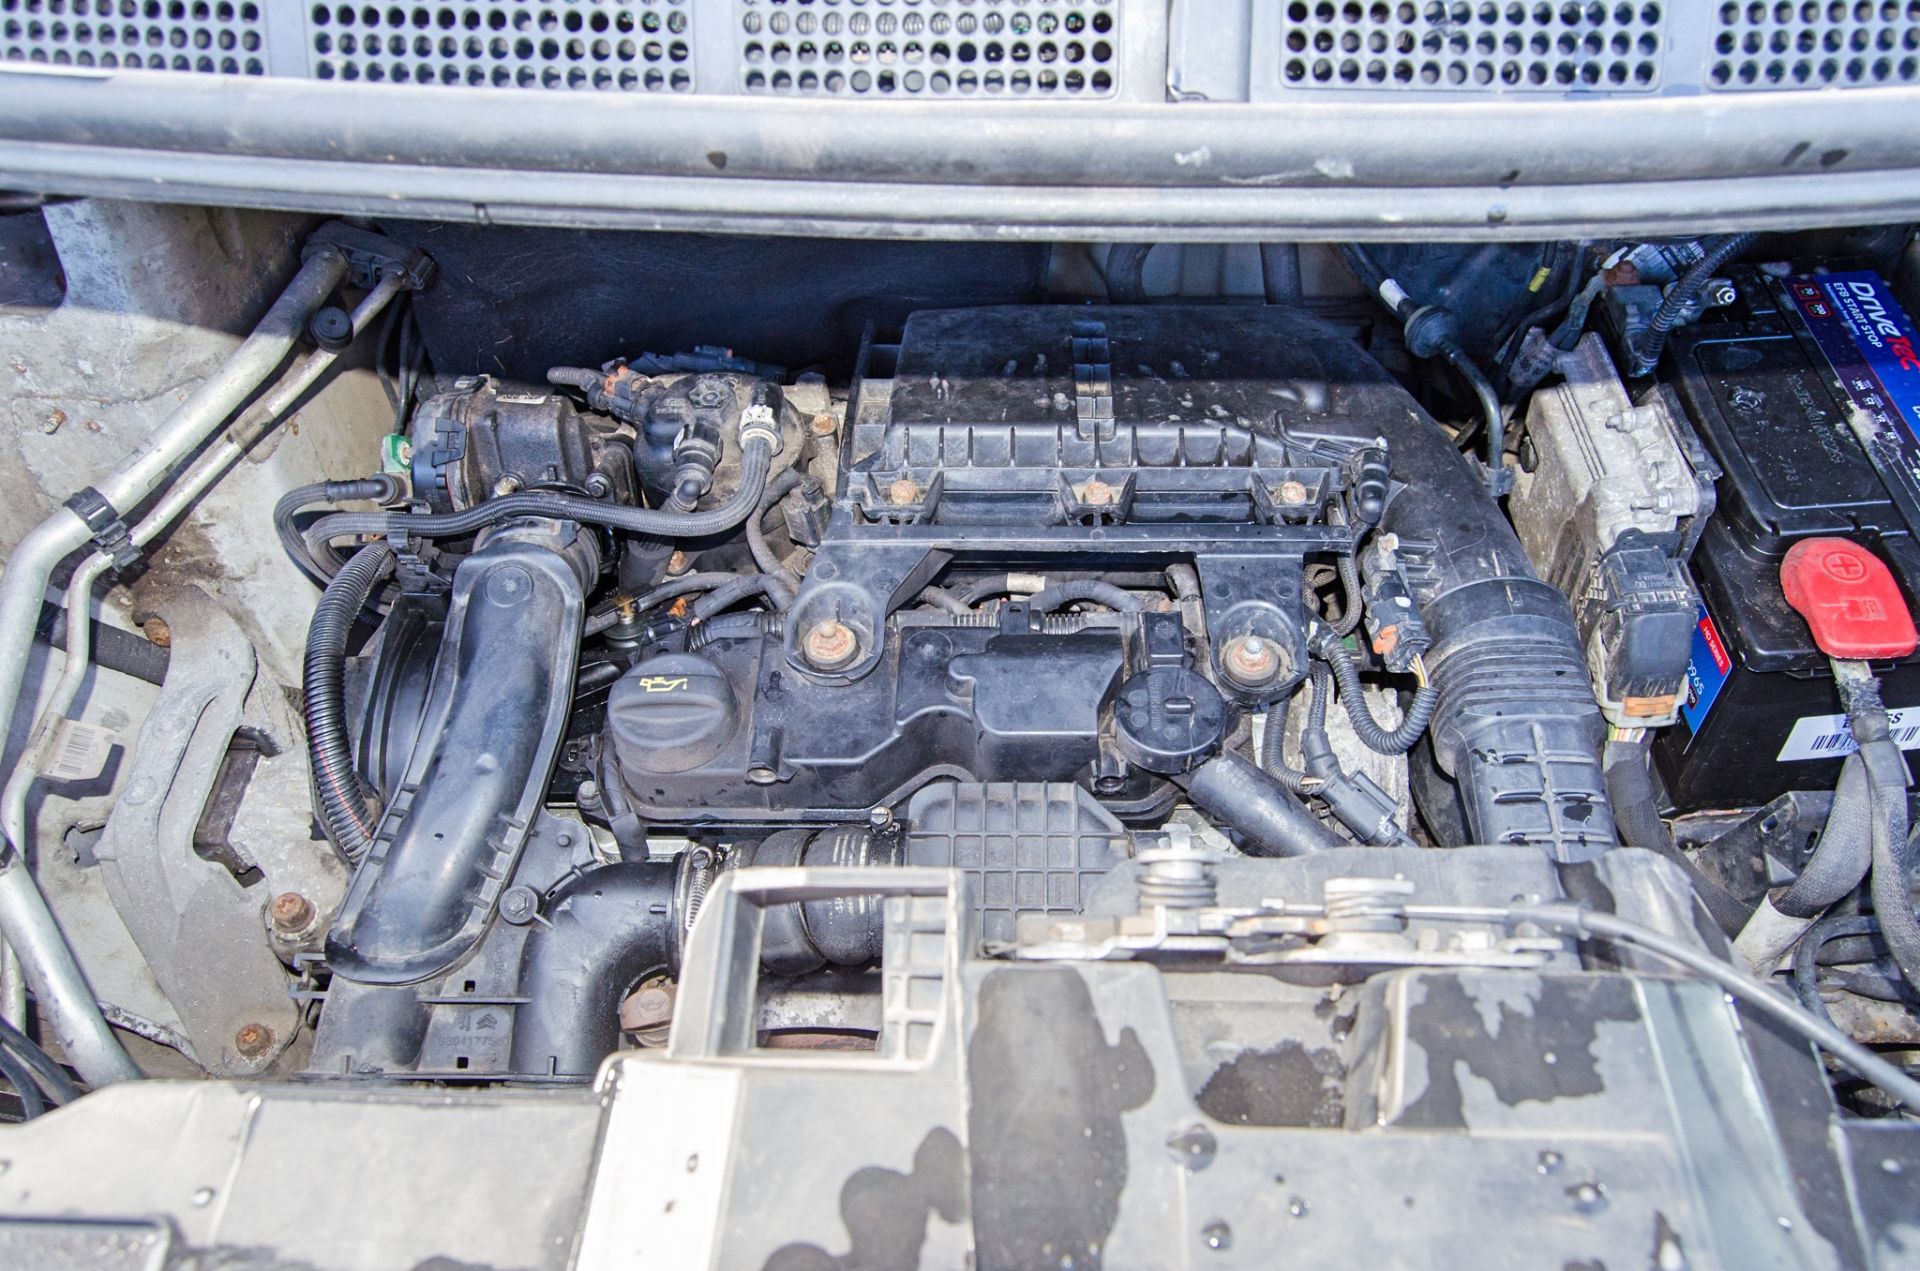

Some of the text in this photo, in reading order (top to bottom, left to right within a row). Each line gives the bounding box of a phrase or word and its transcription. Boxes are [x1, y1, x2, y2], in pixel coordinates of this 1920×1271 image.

[1833, 282, 1883, 348] EFB START STOP
[1709, 640, 1724, 667] SERIES
